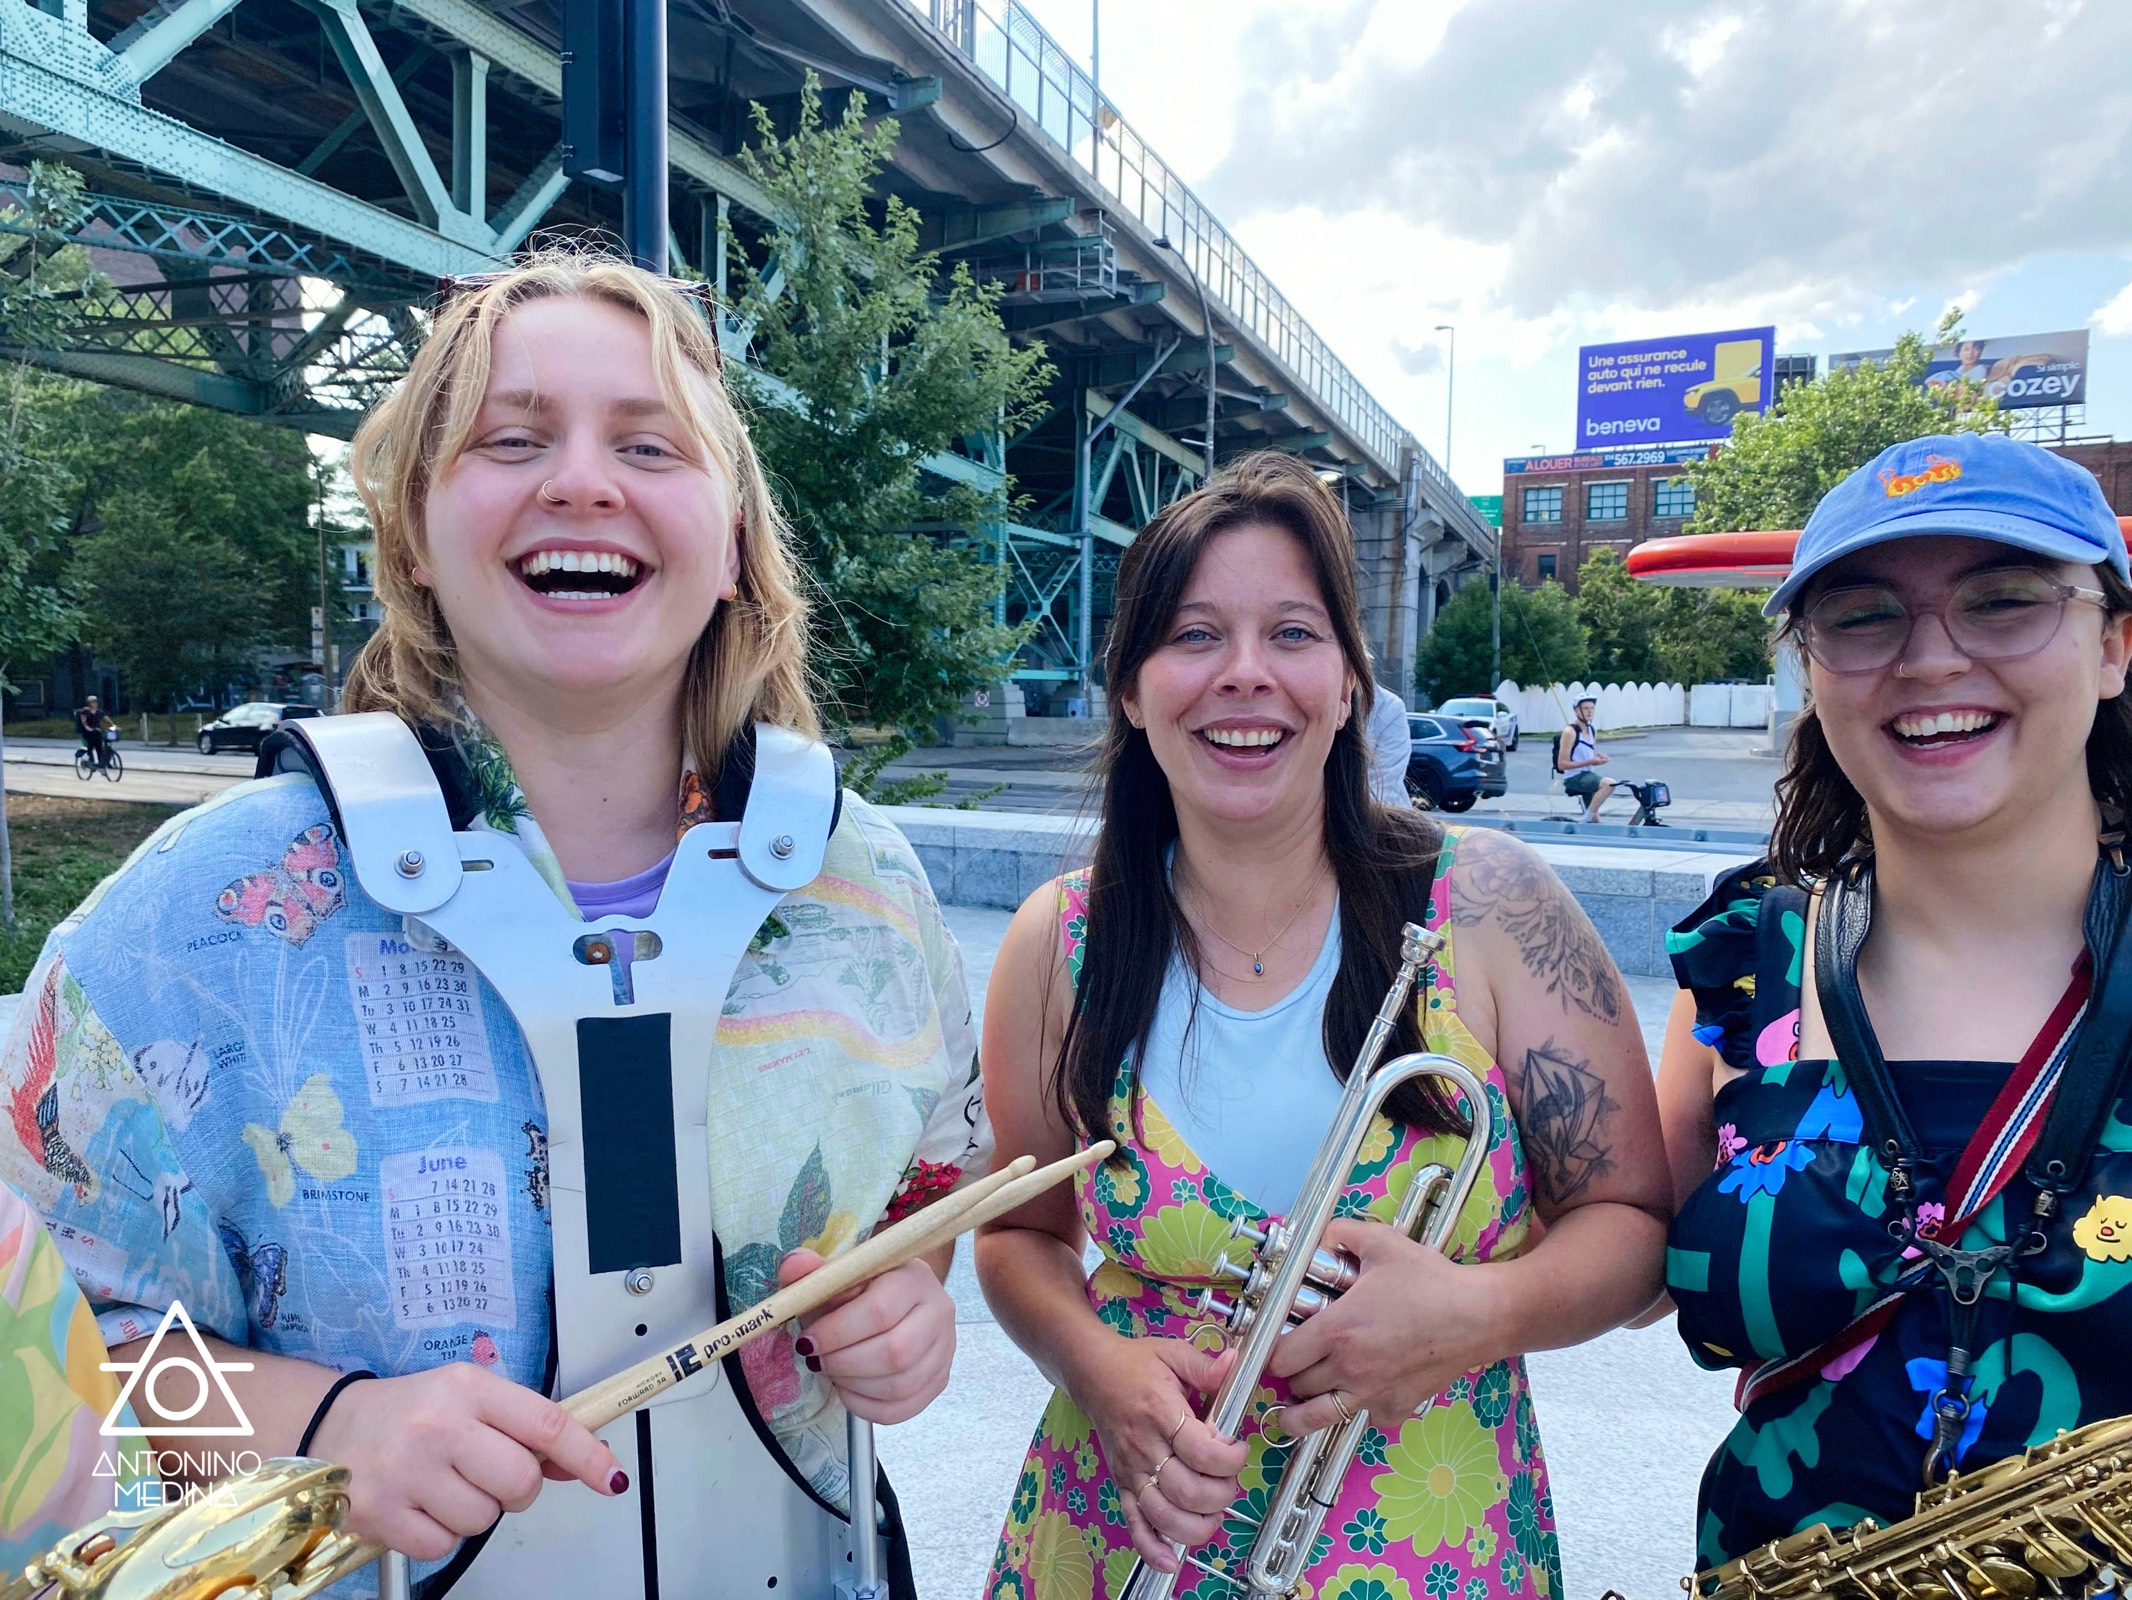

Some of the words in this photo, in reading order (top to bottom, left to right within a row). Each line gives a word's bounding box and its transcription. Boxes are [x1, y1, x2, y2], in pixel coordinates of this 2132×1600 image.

[1588, 355, 1615, 368] Une
[1617, 349, 1687, 365] assurance
[1588, 368, 1618, 381] auto
[1620, 367, 1641, 381] qui
[1644, 364, 1661, 375] ne
[1664, 359, 1707, 374] recule
[1588, 379, 1632, 394] devant
[1636, 377, 1665, 390] rien.
[1988, 374, 2081, 398] cozey
[1586, 417, 1661, 436] beneva
[1614, 451, 1665, 465] 567.2969
[187, 930, 244, 952] PEACOCK
[355, 967, 362, 978] S
[382, 965, 387, 977] 1
[400, 964, 407, 975] 8
[415, 960, 428, 972] 15
[433, 959, 446, 971] 22
[451, 961, 464, 974] 29
[359, 985, 370, 998] M
[384, 984, 391, 996] 2
[402, 982, 409, 993] 9
[418, 979, 431, 991] 16
[435, 978, 449, 990] 23
[454, 980, 467, 993] 30
[362, 1005, 374, 1017] Tu
[387, 1003, 394, 1015] 3
[403, 1001, 416, 1012] 10
[421, 998, 433, 1010] 17
[440, 997, 452, 1009] 24
[457, 999, 470, 1012] 31
[365, 1023, 376, 1036] W
[390, 1022, 397, 1034] 4
[407, 1019, 418, 1031] 11
[425, 1016, 438, 1028] 18
[441, 1016, 456, 1028] 25
[369, 1042, 383, 1054] Th
[394, 1041, 401, 1052] 5
[410, 1038, 423, 1050] 12
[429, 1036, 441, 1048] 19
[445, 1035, 460, 1048] 26
[373, 1061, 380, 1073] F
[398, 1059, 405, 1071] 6
[414, 1057, 427, 1069] 13
[431, 1055, 445, 1067] 20
[449, 1054, 462, 1067] 27
[376, 1081, 382, 1092] S
[400, 1078, 408, 1091] 7
[417, 1076, 431, 1089] 14
[435, 1073, 447, 1086] 21
[452, 1073, 468, 1086] 28
[418, 1156, 467, 1174] June
[303, 1189, 370, 1202] BRIMSTONE
[388, 1187, 395, 1200] S
[432, 1180, 438, 1193] 7
[446, 1179, 458, 1191] 14
[463, 1179, 476, 1193] 21
[482, 1182, 495, 1196] 28
[390, 1207, 400, 1219] M
[415, 1204, 420, 1217] 1
[433, 1201, 441, 1213] 8
[446, 1199, 459, 1212] 15
[465, 1200, 479, 1213] 22
[483, 1203, 498, 1217] 29
[391, 1227, 405, 1240] Tu
[416, 1224, 424, 1236] 2
[435, 1221, 442, 1232] 9
[448, 1219, 463, 1232] 16
[466, 1220, 482, 1235] 23
[486, 1223, 500, 1238] 30
[394, 1246, 405, 1259] W
[419, 1244, 426, 1257] 3
[435, 1242, 447, 1255] 10
[452, 1240, 464, 1253] 17
[468, 1242, 483, 1254] 24
[397, 1266, 411, 1278] Th
[422, 1264, 429, 1276] 4
[438, 1262, 450, 1275] 11
[453, 1260, 467, 1272] 18
[471, 1261, 485, 1274] 25
[400, 1286, 406, 1297] F
[425, 1283, 432, 1295] 5
[441, 1282, 453, 1294] 12
[455, 1280, 468, 1291] 19
[473, 1281, 487, 1292] 26
[402, 1304, 409, 1316] S
[427, 1302, 434, 1313] 6
[443, 1299, 456, 1310] 13
[457, 1297, 471, 1307] 20
[475, 1298, 488, 1310] 27
[424, 1335, 468, 1350] ORANGE
[441, 1350, 457, 1360] TIP
[618, 1384, 654, 1407] FORWARD
[657, 1377, 666, 1386] 5A
